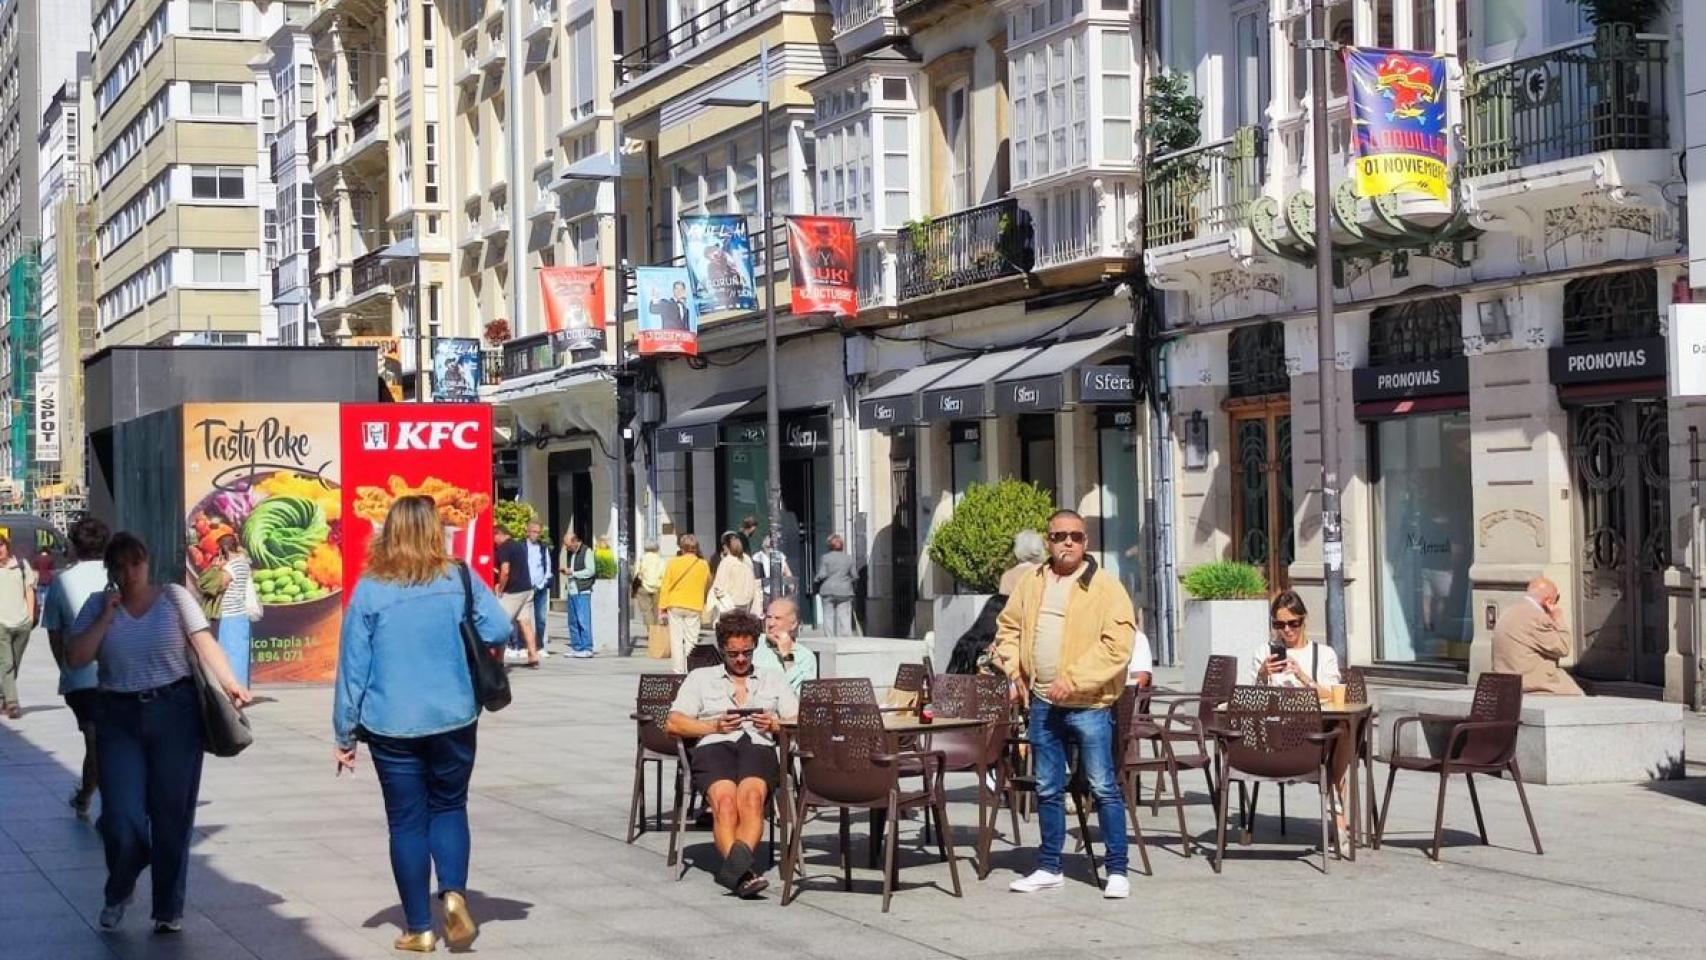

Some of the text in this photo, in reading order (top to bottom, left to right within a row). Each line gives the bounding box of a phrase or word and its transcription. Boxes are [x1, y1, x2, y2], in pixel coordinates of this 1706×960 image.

[1364, 157, 1443, 178] 01 NOVIEMBR
[1568, 349, 1647, 372] PRONOVIAS
[1377, 369, 1441, 390] PRONOVIAS
[41, 399, 55, 442] SPOT
[194, 417, 311, 466] Tasty Poke
[394, 421, 480, 450] KFC
[270, 636, 303, 649] Tapia
